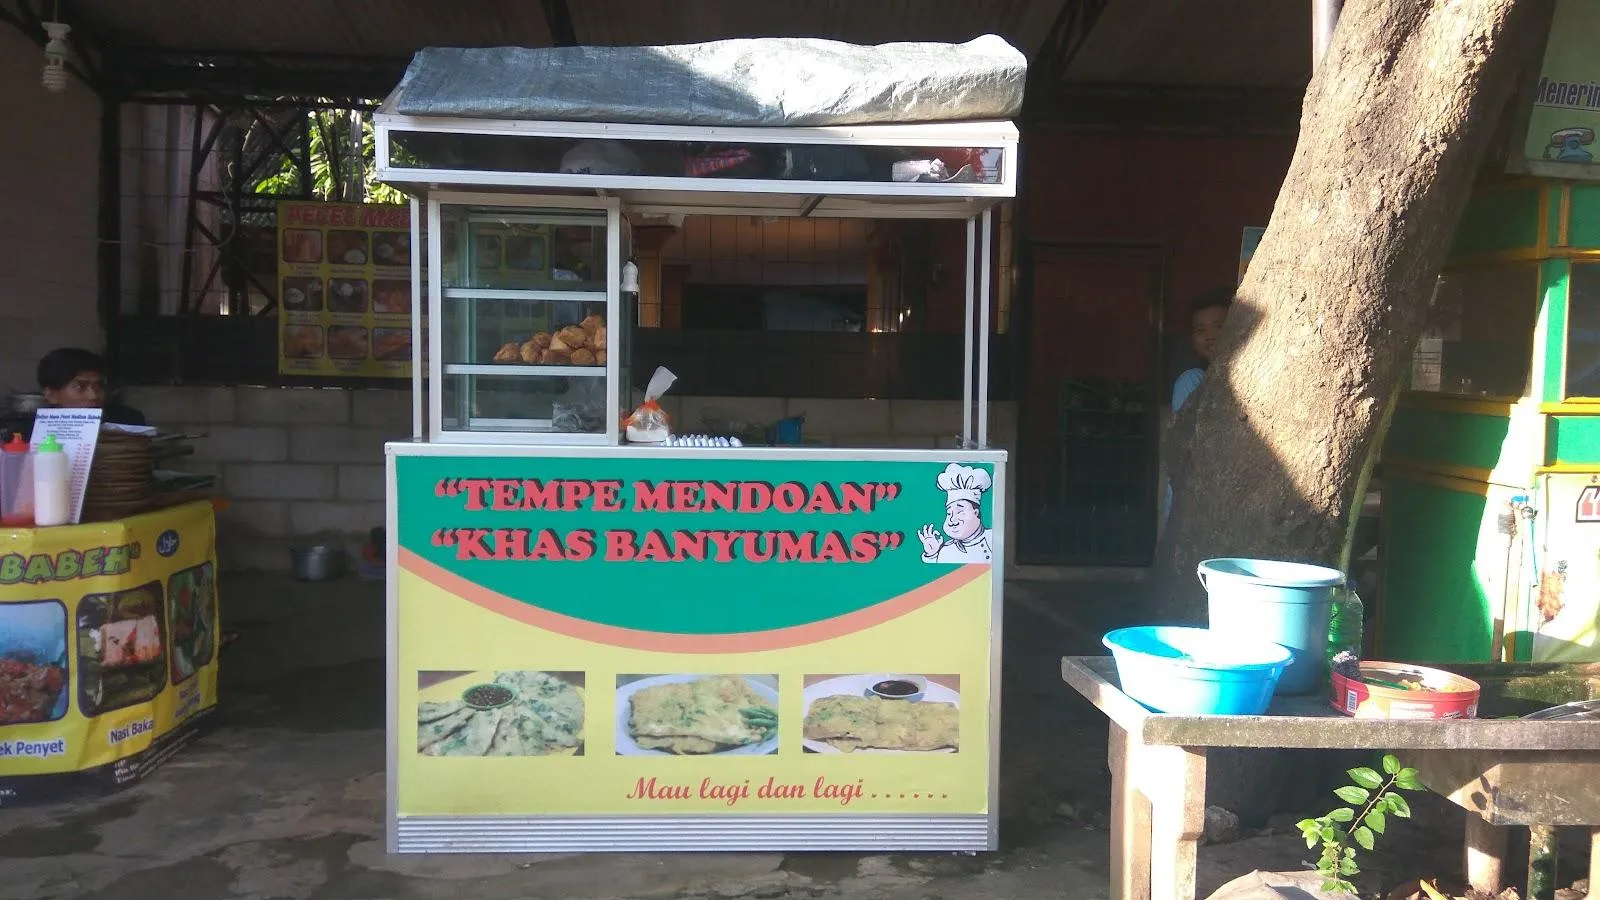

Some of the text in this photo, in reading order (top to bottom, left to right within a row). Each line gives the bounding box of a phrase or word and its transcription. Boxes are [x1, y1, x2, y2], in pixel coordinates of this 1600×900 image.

[109, 719, 155, 744] Nasi Baka
[0, 740, 64, 757] ek Penyet
[626, 776, 692, 800] Mau
[699, 776, 750, 806] lagi
[757, 776, 806, 799] dan
[813, 776, 864, 806] lagi
